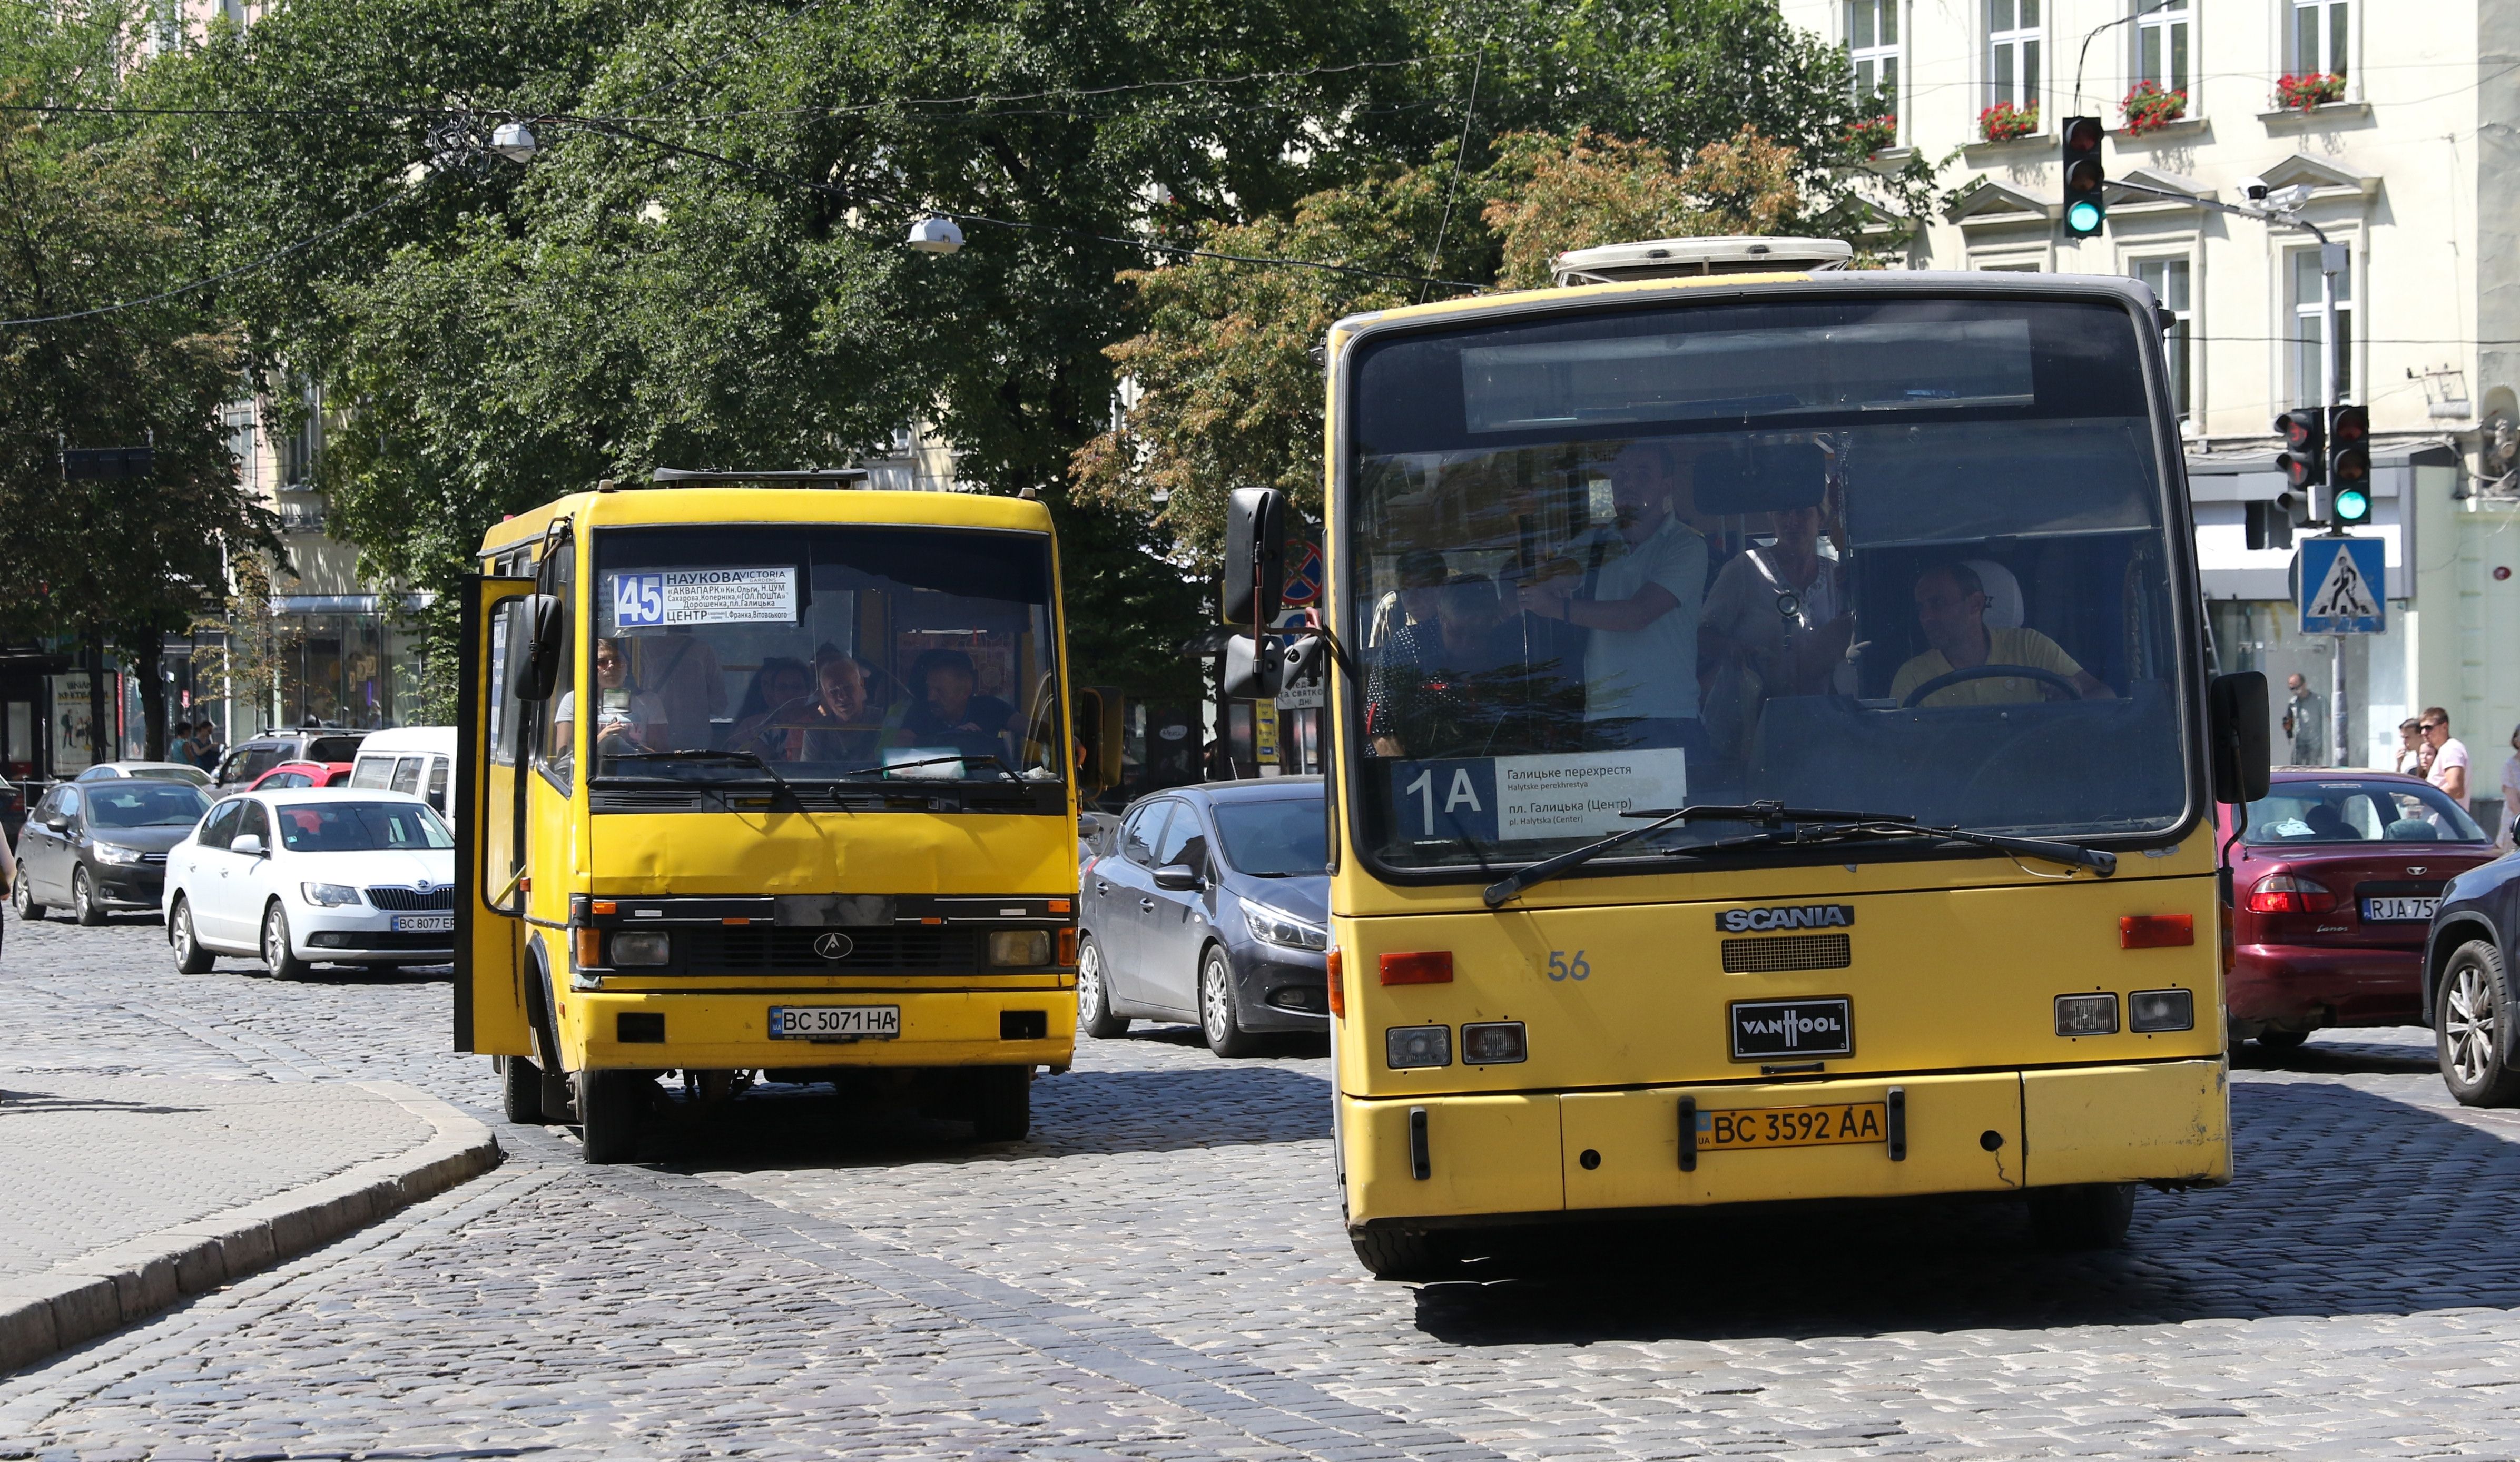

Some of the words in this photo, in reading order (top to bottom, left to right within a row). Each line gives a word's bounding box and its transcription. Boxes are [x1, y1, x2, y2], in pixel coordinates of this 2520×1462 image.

[667, 572, 742, 584] НАУКОВА
[619, 577, 662, 622] 45
[667, 611, 707, 623] ЦЕНТР
[1508, 769, 1561, 781] Галицьке
[1565, 766, 1631, 779] перехрестя
[1508, 783, 1538, 791] Halytske
[1540, 781, 1588, 790] perekhrestya
[1510, 805, 1526, 814] пл.
[1531, 802, 1583, 813] Галицька
[1588, 798, 1632, 812] (Центр)
[1521, 816, 1551, 825] Halytska
[1553, 815, 1583, 824] (Center)
[2372, 900, 2407, 918] RJA
[400, 918, 414, 929] BC
[417, 918, 440, 928] 8077
[1724, 906, 1846, 931] SCANIA
[1547, 950, 1590, 982] 56
[783, 1012, 811, 1030] BC
[818, 1012, 860, 1030] 5071
[867, 1011, 895, 1029] HA
[1698, 1137, 1710, 1145] UA
[1715, 1115, 1756, 1144] BC
[1765, 1112, 1830, 1141] 3592
[1839, 1110, 1879, 1138] AA
